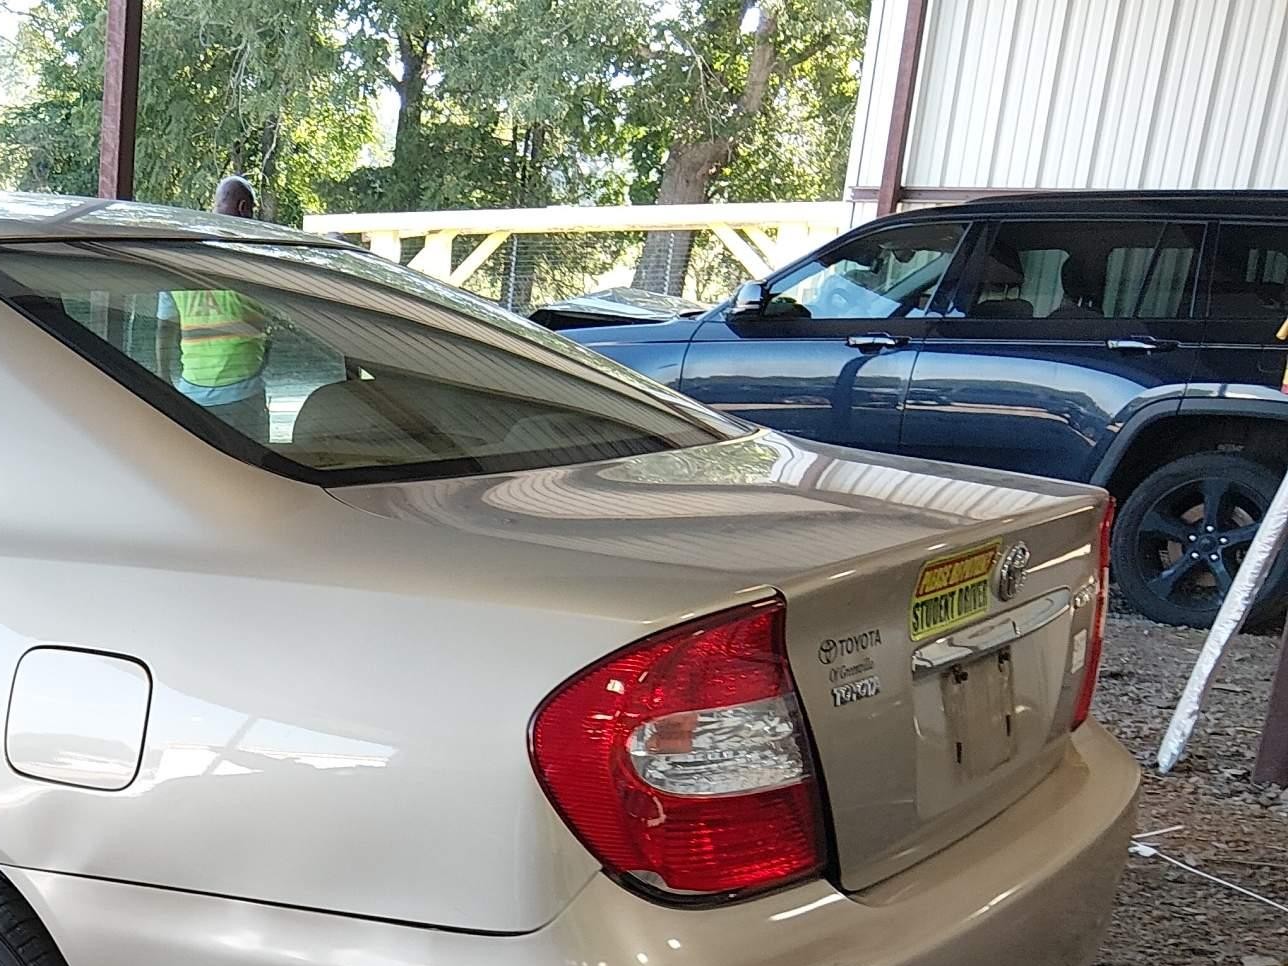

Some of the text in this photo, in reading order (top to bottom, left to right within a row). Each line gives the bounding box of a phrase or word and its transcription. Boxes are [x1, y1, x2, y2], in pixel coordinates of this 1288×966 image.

[911, 578, 988, 633] STUDENT DRIVER
[838, 628, 882, 657] TOYOTA
[830, 674, 881, 708] TOYOTA
